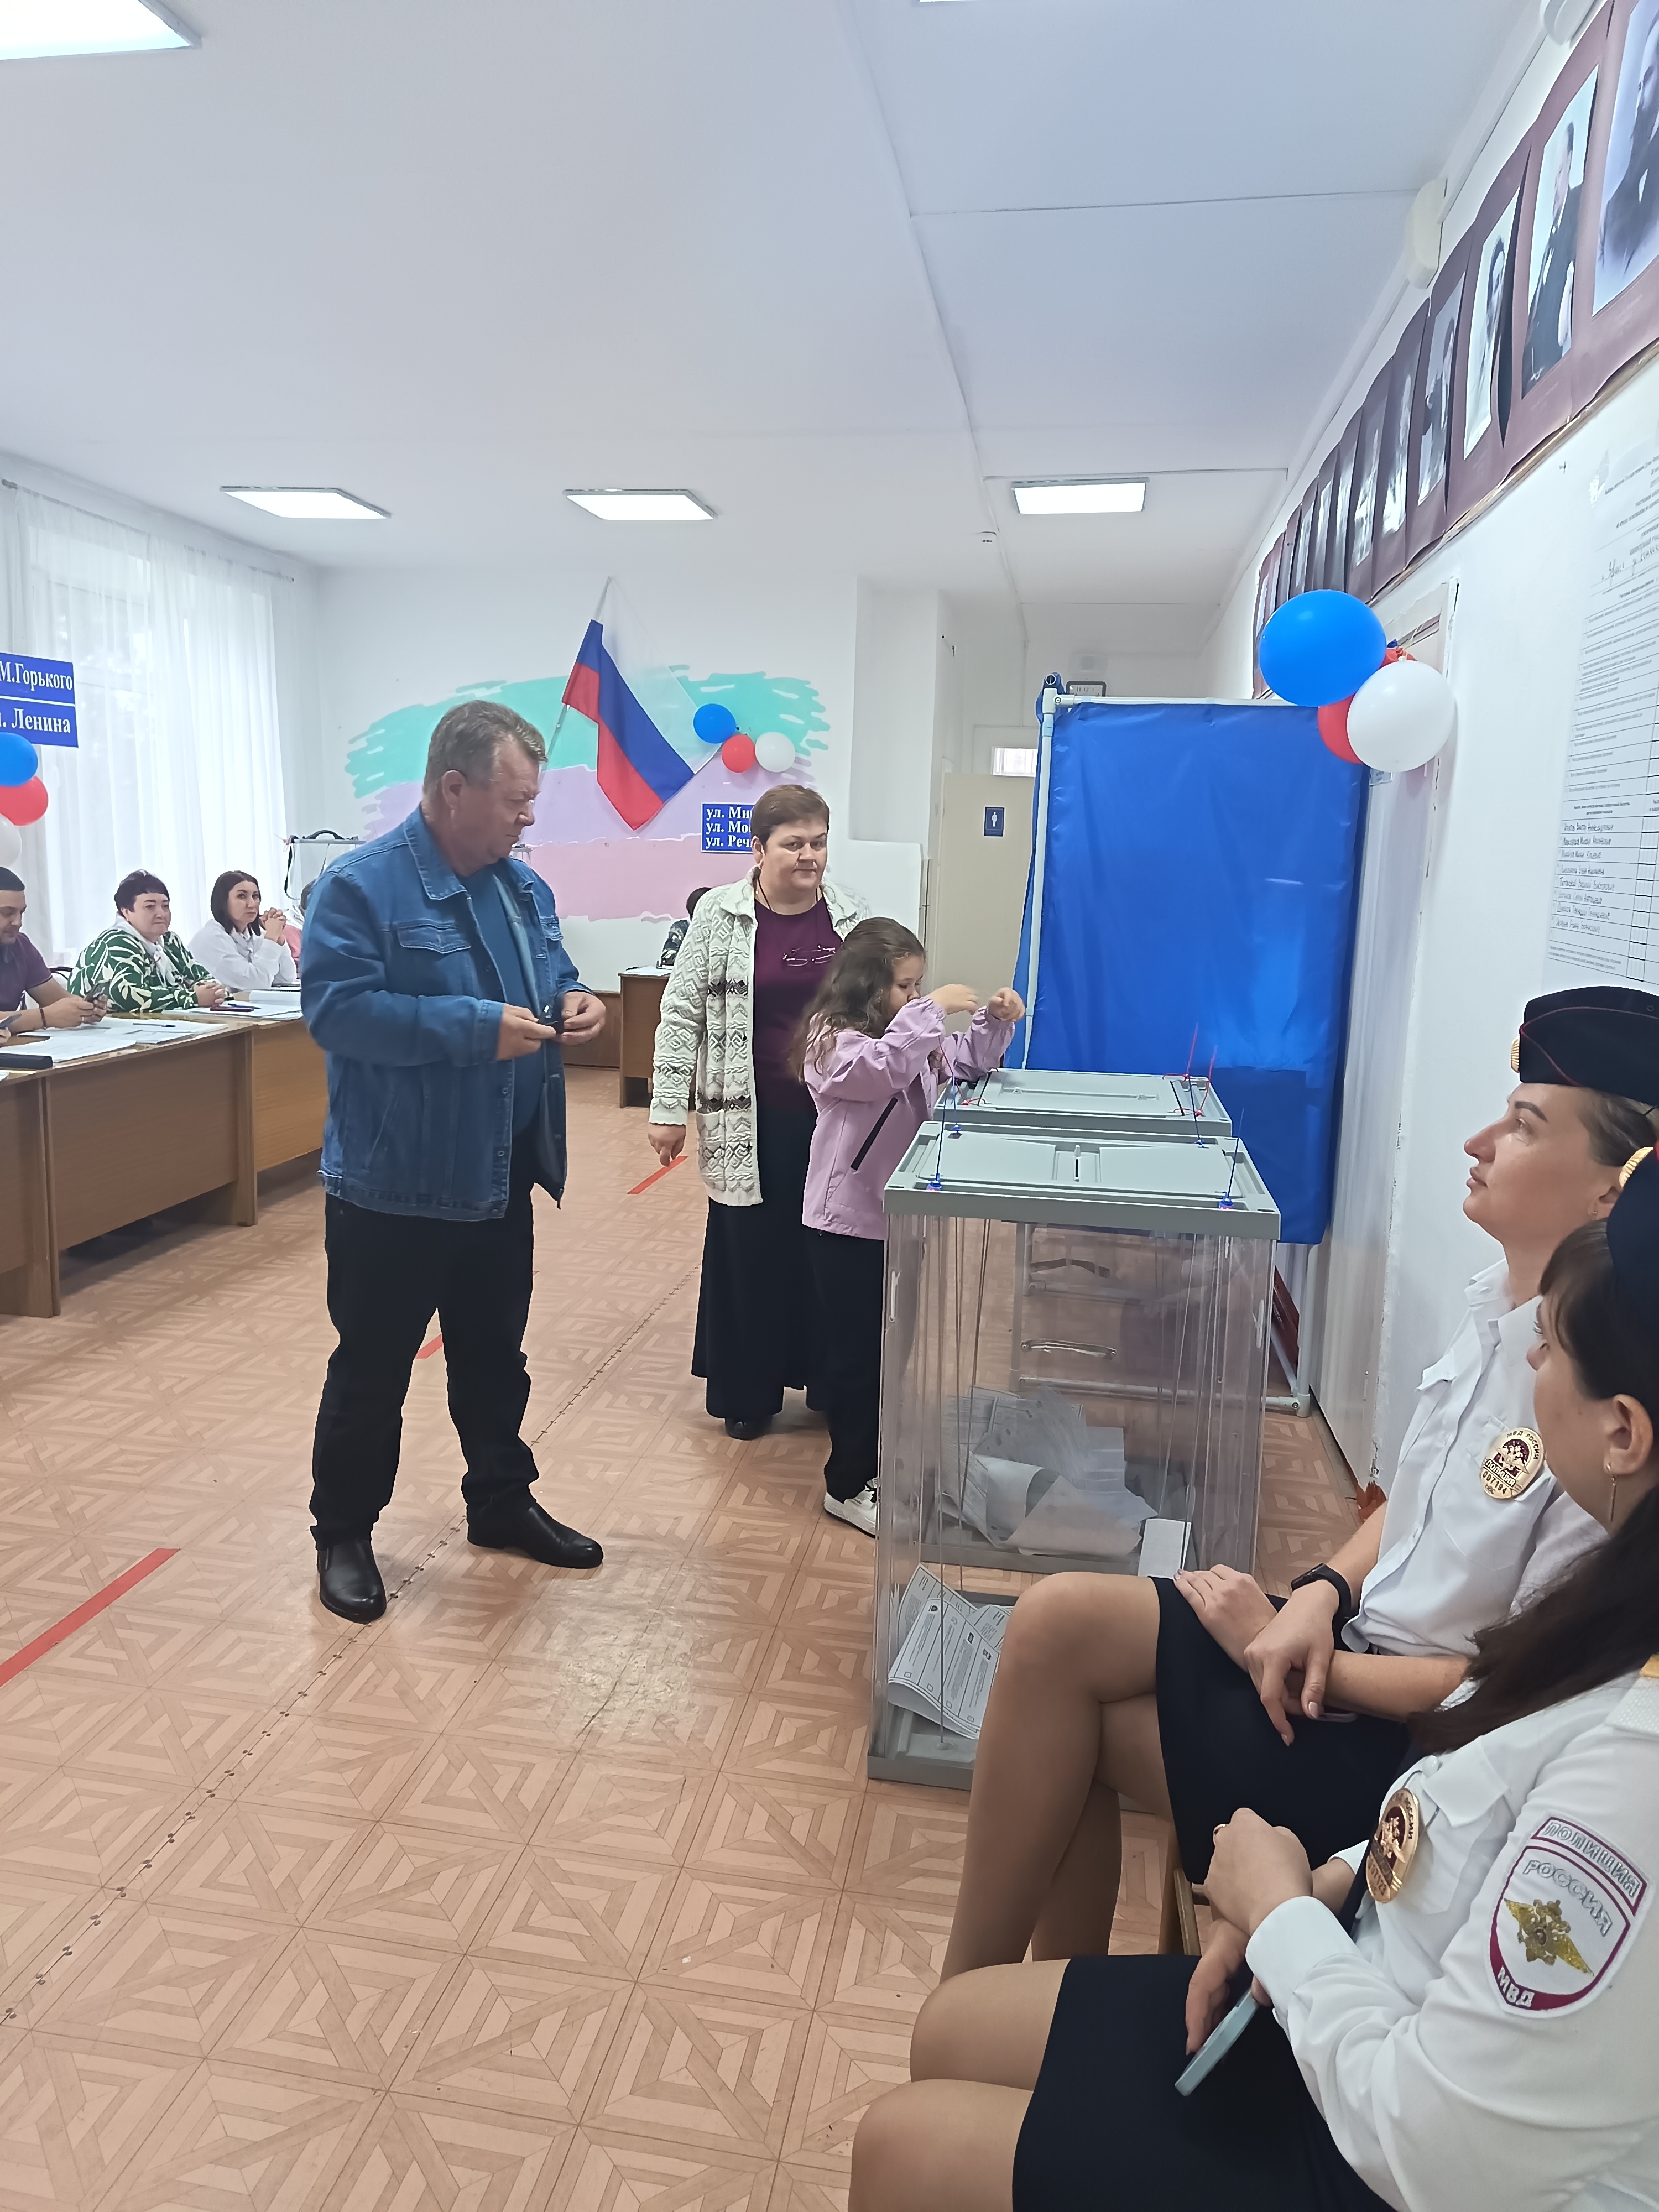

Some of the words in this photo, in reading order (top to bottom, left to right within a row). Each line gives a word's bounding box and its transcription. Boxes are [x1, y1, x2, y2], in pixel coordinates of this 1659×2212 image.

[0, 661, 73, 691] М.Горького
[11, 708, 71, 733] Ленина
[706, 808, 724, 821] ул.
[728, 806, 752, 818] Ми
[705, 837, 724, 849] ул.
[728, 834, 752, 847] Реч
[706, 823, 724, 835] ул.
[1526, 1433, 1540, 1459] РОССИИ
[1486, 1460, 1515, 1486] ПОЛИЦИЯ
[1543, 1822, 1641, 1898] ПОЛИЦИЯ
[1523, 1860, 1613, 1937] РОССИЯ
[1498, 1966, 1535, 2008] МВД
